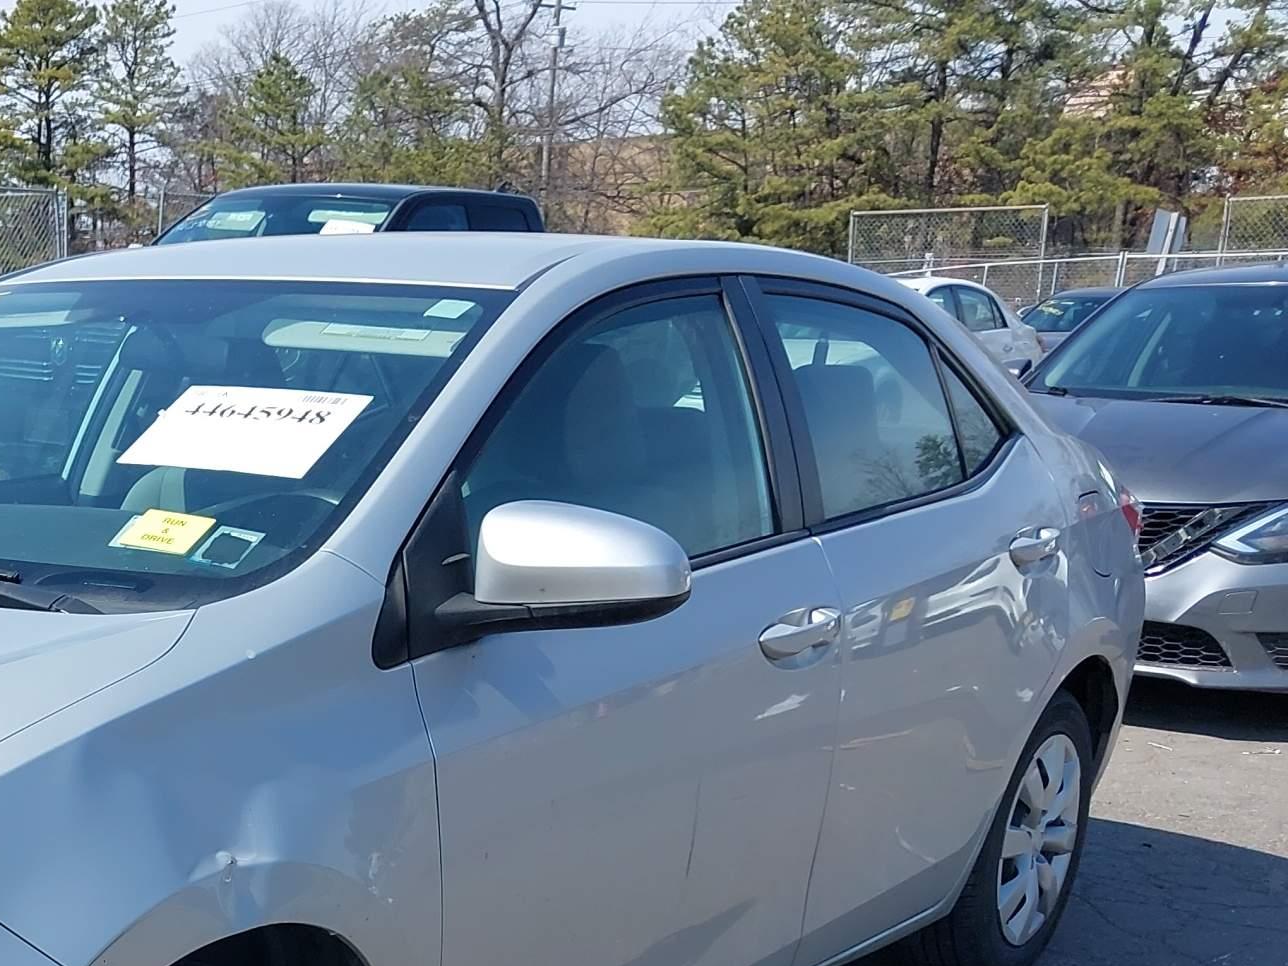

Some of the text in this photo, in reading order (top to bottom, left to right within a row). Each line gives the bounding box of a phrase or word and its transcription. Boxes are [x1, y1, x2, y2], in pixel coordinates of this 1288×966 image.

[185, 402, 331, 424] 44645948
[162, 517, 187, 526] RUN
[141, 534, 174, 544] DRIVE
